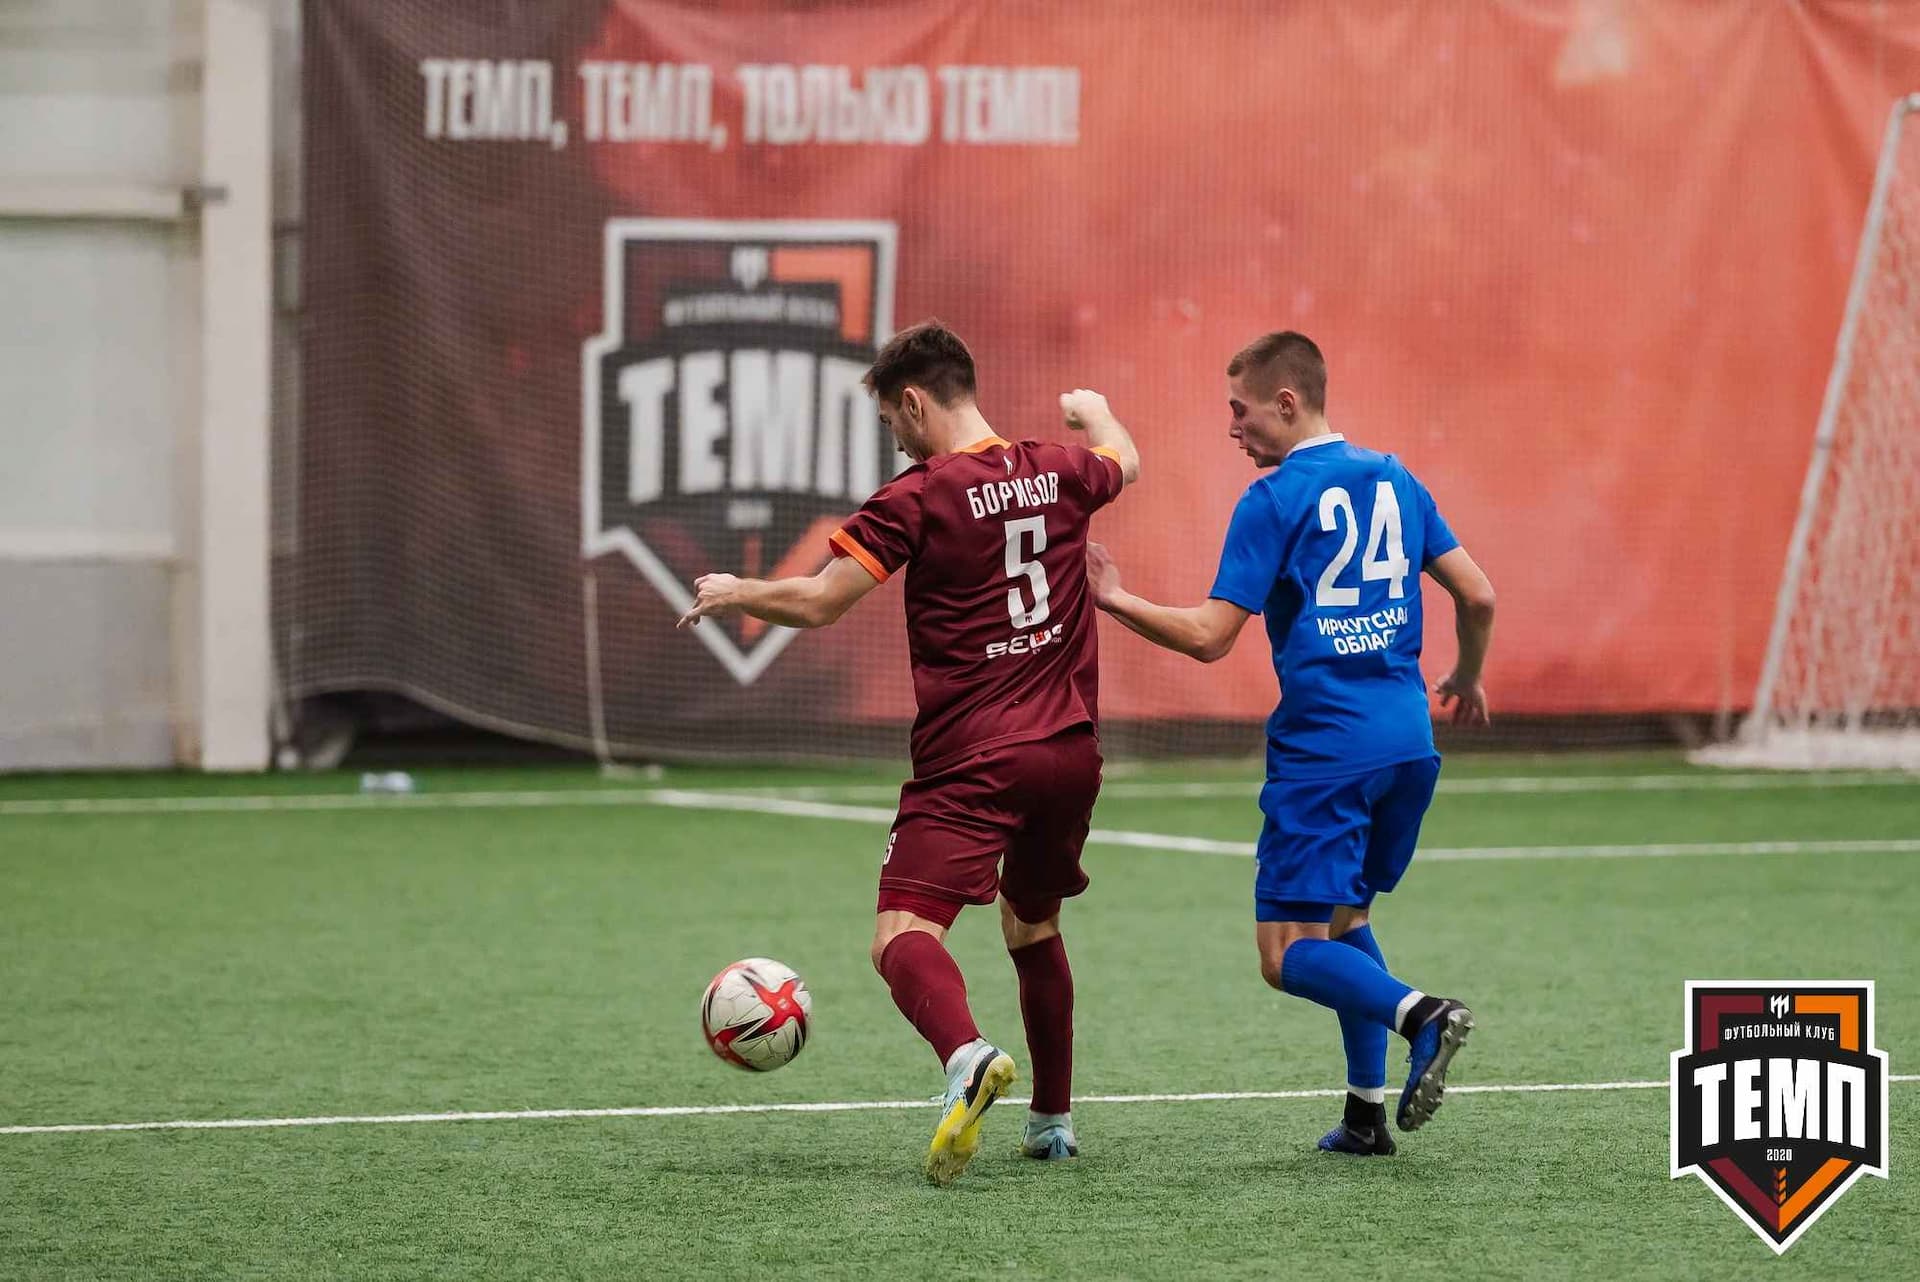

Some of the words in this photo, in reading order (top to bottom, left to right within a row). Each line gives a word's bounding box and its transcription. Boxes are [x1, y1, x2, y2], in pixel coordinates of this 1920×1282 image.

[420, 59, 568, 150] ТЕМП,
[580, 60, 728, 151] ТЕМП,
[735, 63, 930, 146] ТОЛЬКО
[618, 350, 880, 504] ТЕМП
[966, 471, 1059, 519] БОРИСОВ
[1316, 481, 1410, 607] 24
[1004, 515, 1050, 629] 5
[1316, 606, 1408, 636] ИРКУТСКА
